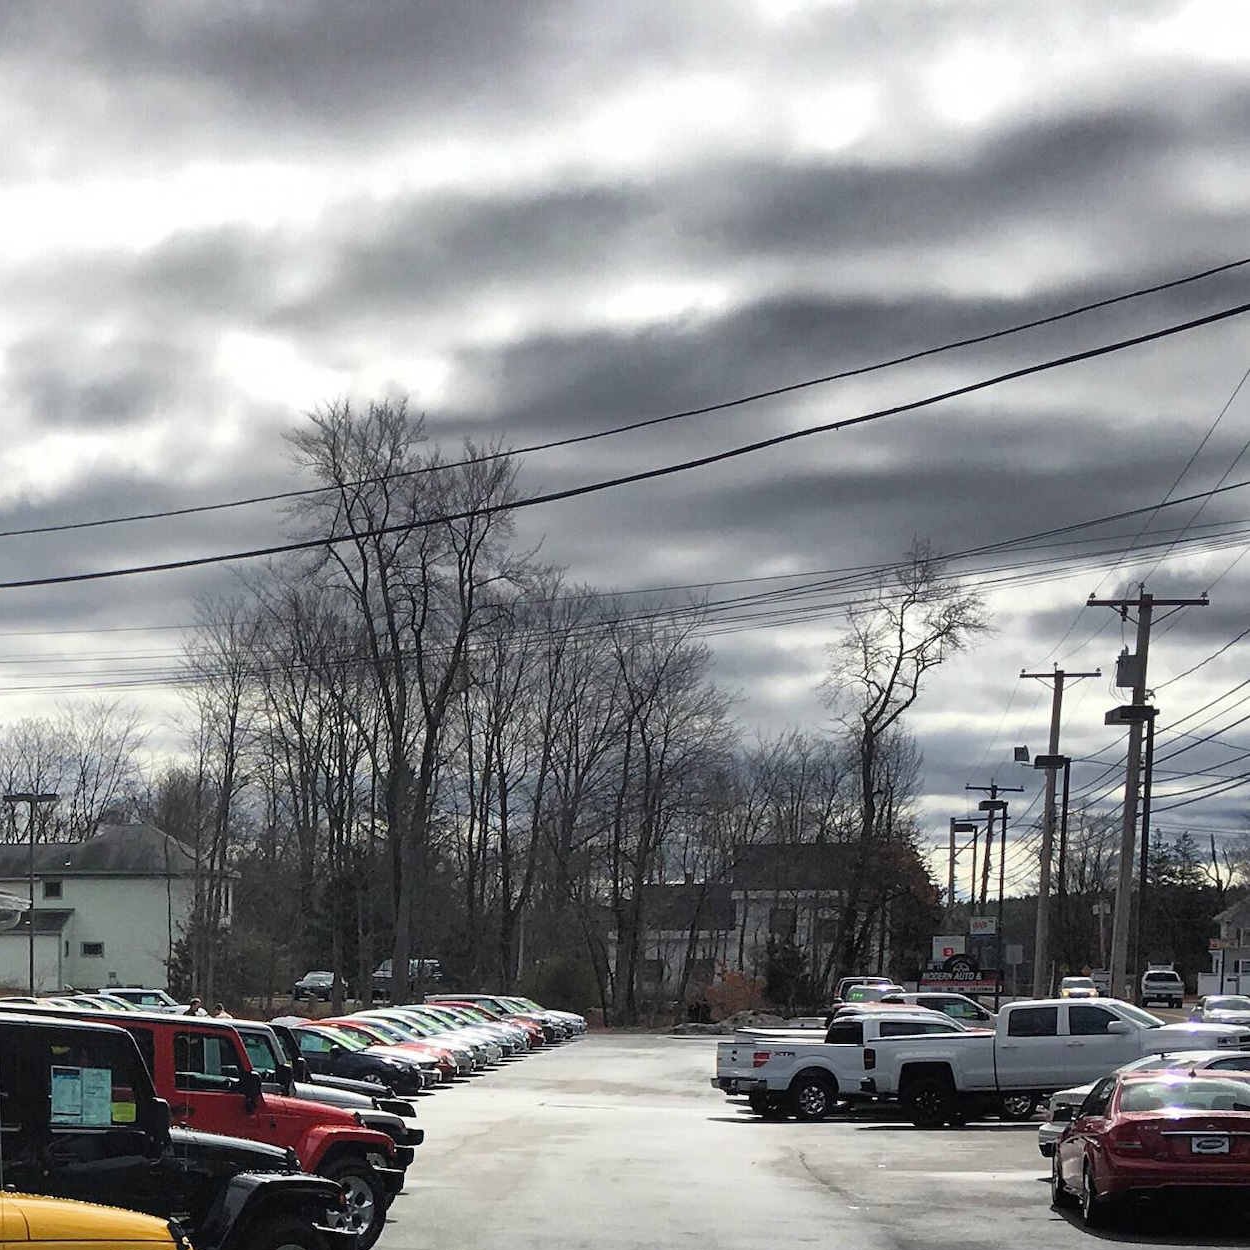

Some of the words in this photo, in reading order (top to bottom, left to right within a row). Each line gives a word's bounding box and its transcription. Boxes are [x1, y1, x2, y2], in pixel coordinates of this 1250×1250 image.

[922, 972, 953, 981] MODERN
[954, 972, 975, 981] AUTO
[975, 972, 982, 980] &
